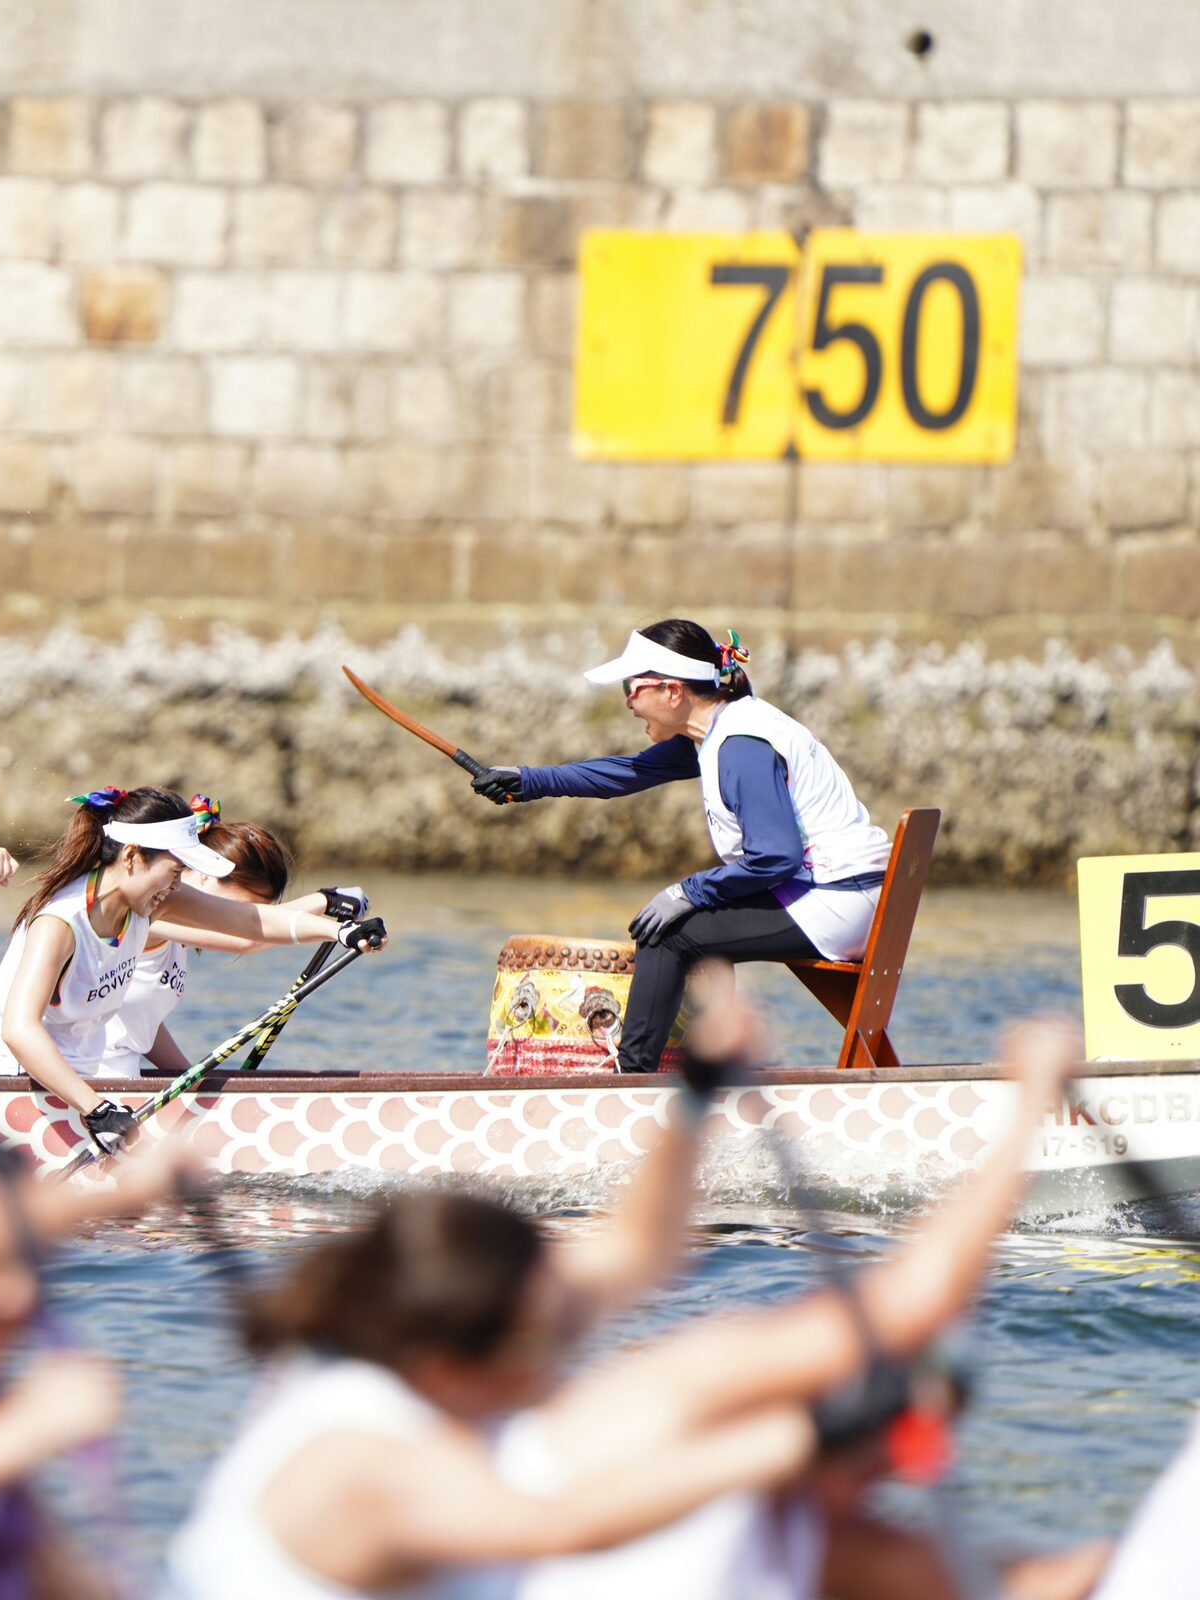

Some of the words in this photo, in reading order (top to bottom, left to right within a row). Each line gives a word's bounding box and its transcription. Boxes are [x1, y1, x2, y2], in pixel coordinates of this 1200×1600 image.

[710, 261, 981, 431] 750
[86, 964, 136, 1003] BONVO
[1114, 869, 1200, 1029] 5
[1040, 1091, 1200, 1126] HKCDB
